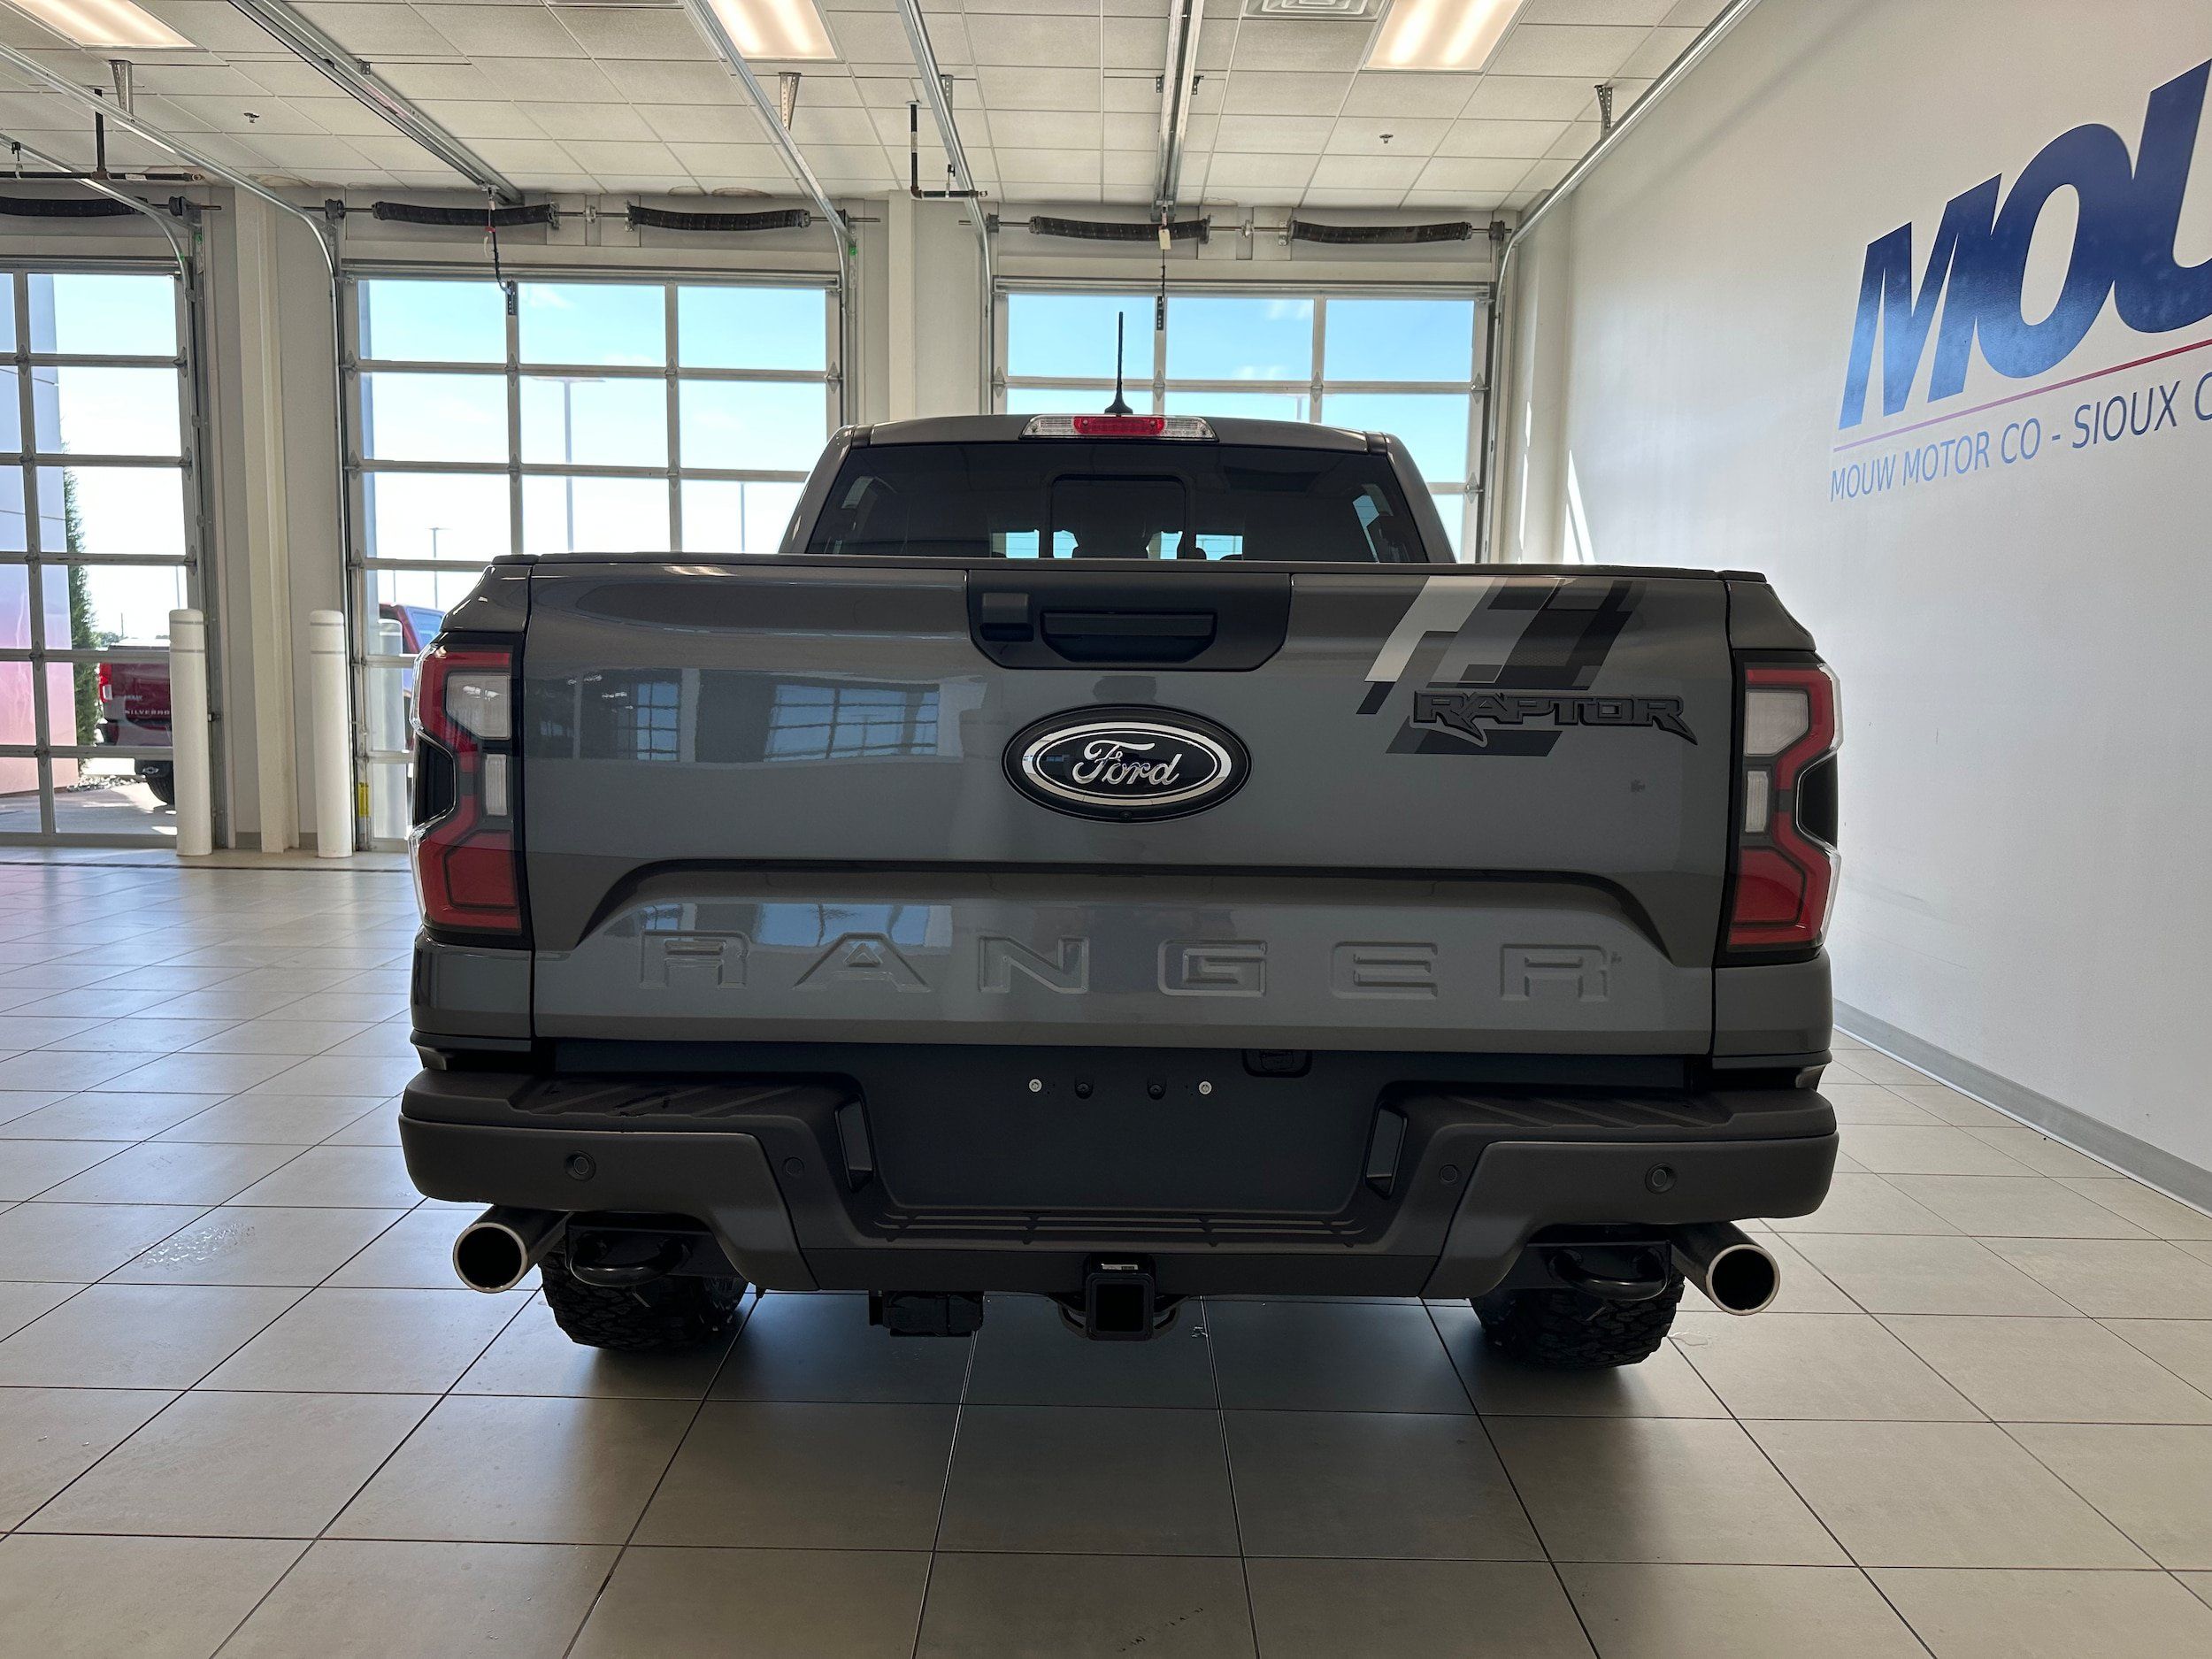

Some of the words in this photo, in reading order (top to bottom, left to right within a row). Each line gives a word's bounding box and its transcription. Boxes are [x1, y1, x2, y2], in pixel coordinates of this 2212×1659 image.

[1831, 454, 1896, 503] MOUW
[1903, 431, 1990, 487] MOTOR
[2001, 418, 2041, 465] CO
[2072, 380, 2182, 449] SIOUX
[1414, 690, 1698, 746] RAPTOR
[1071, 740, 1183, 786] Ford
[639, 928, 1609, 1003] RANGER
